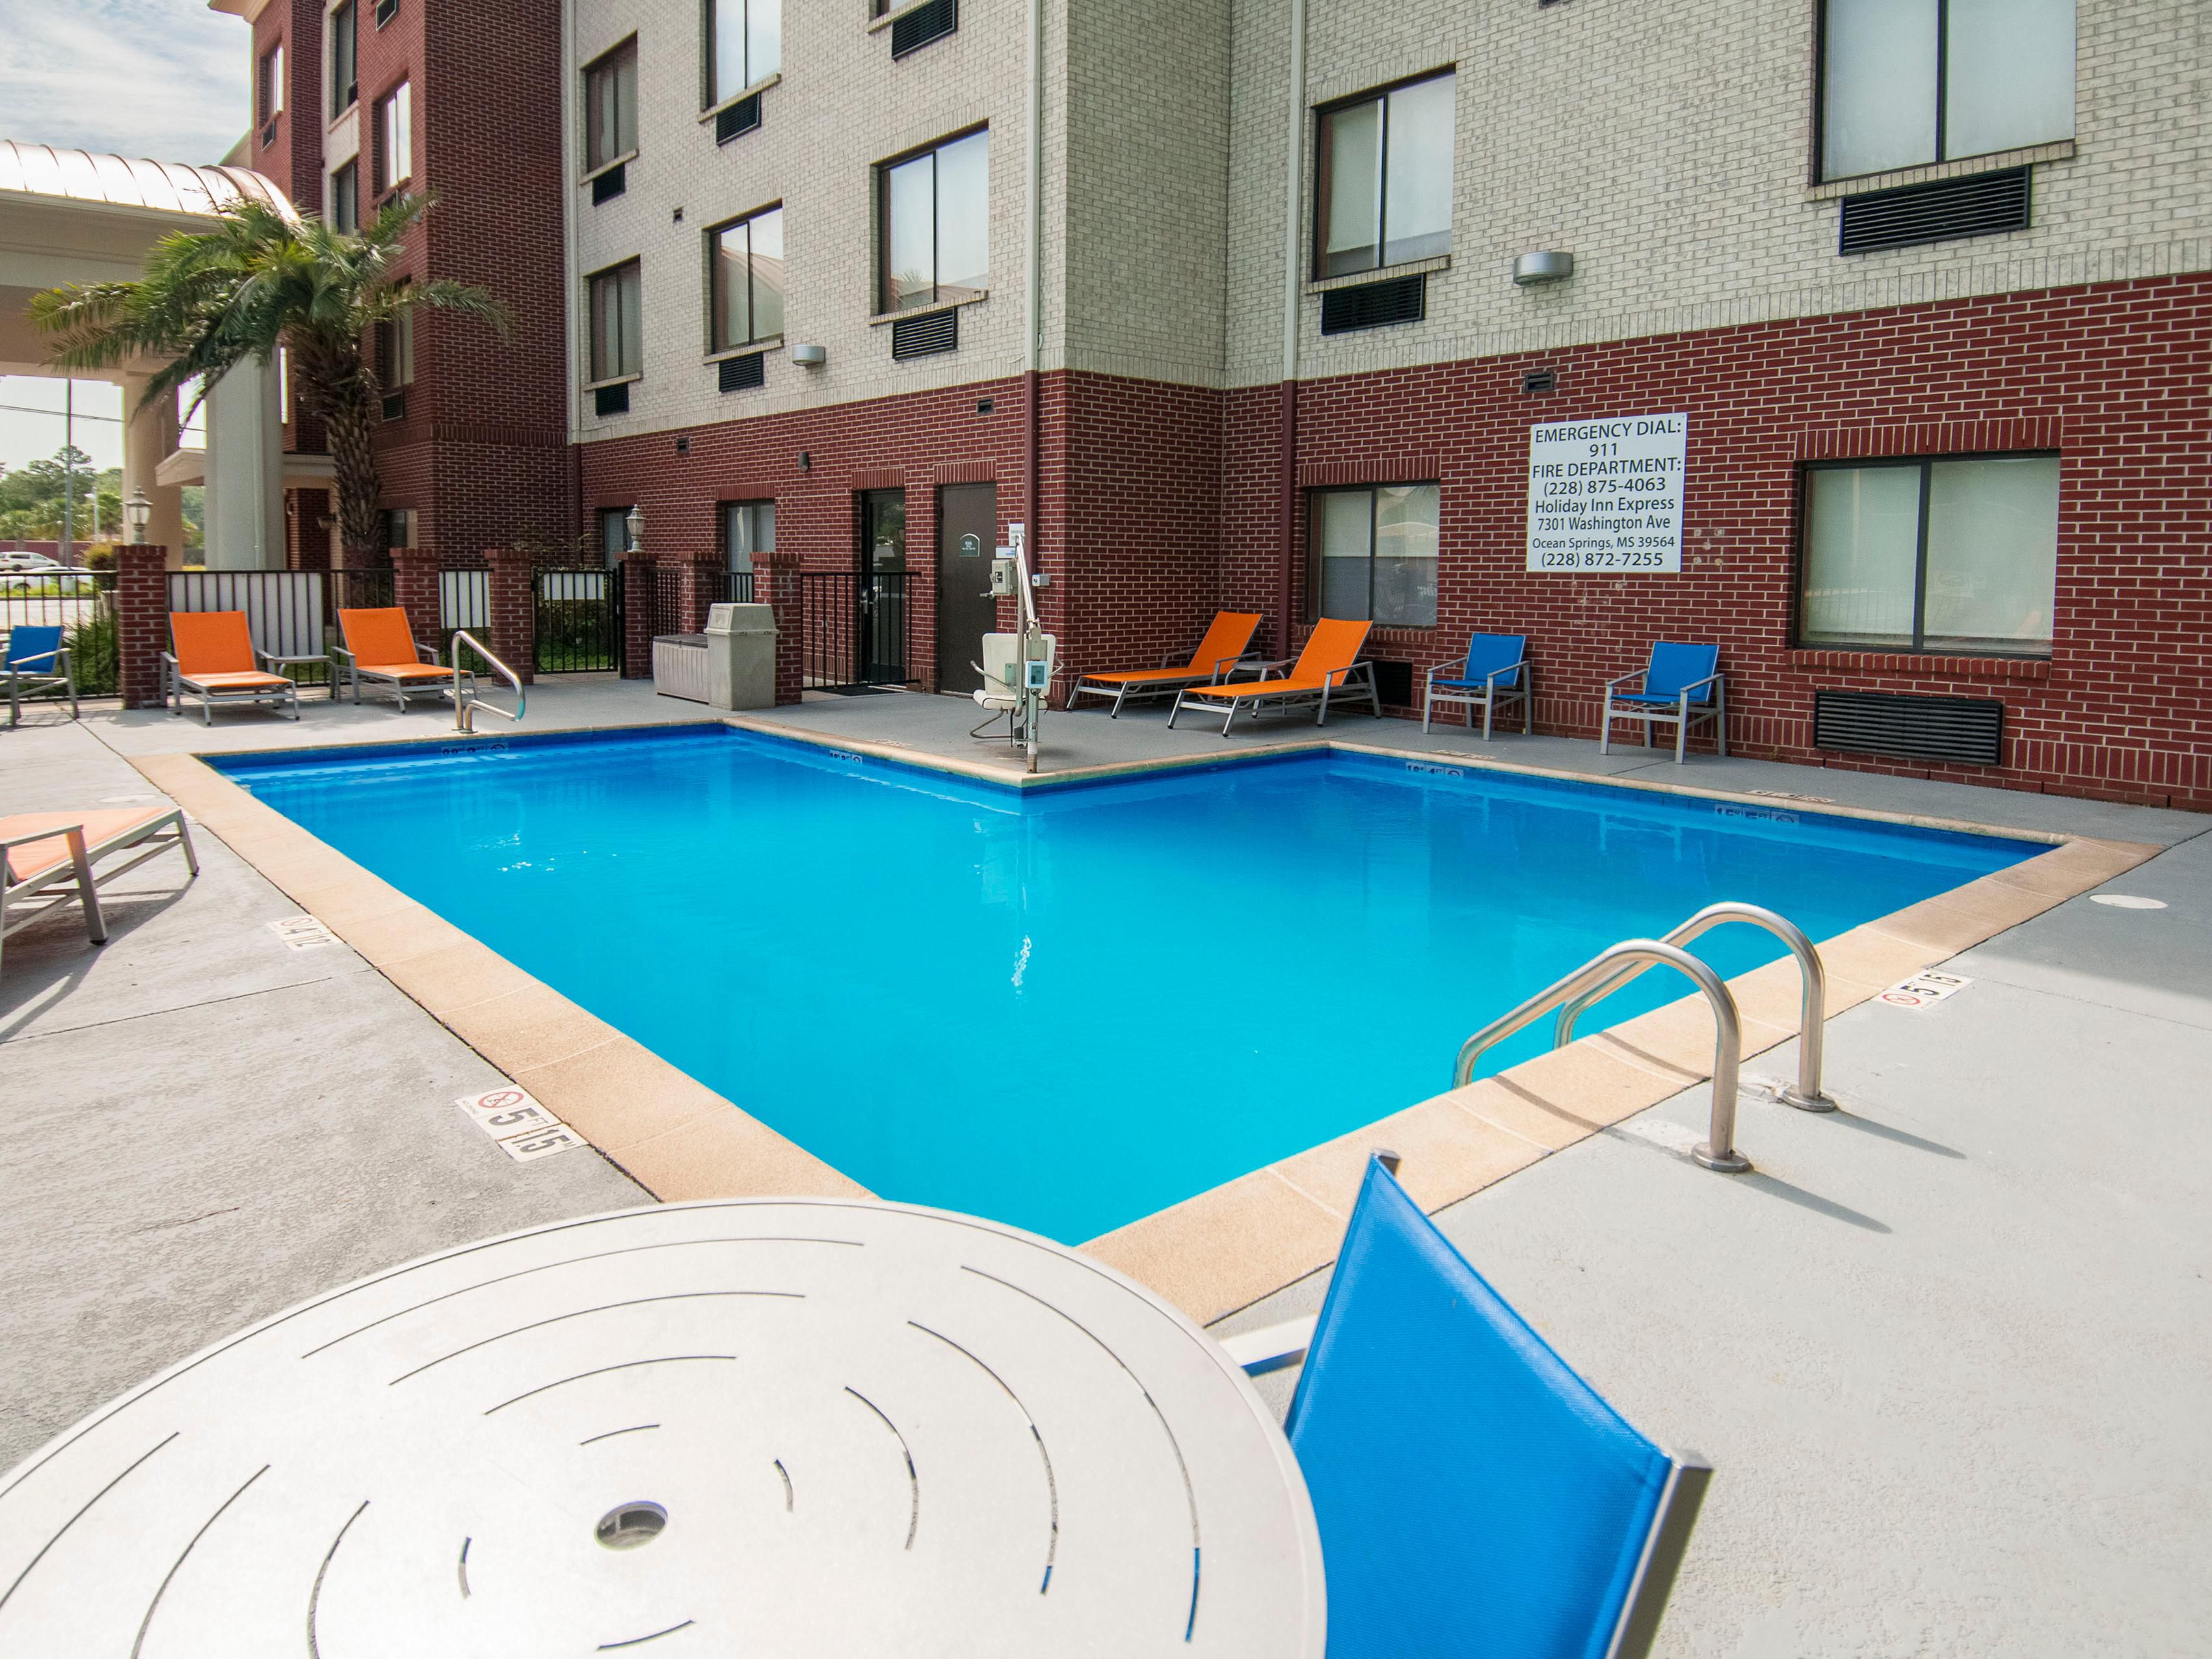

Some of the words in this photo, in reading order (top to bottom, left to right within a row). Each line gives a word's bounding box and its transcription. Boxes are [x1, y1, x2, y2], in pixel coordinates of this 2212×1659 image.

[1536, 422, 1632, 443] EMERGENCY
[1636, 419, 1681, 435] DIAL:
[1590, 443, 1618, 457] 911
[1532, 464, 1564, 479] FIRE
[1567, 457, 1681, 477] DEPARTMENT:
[1544, 480, 1582, 497] (228)
[1587, 477, 1666, 493] 875-4063
[1535, 499, 1588, 515] Holiday
[1591, 498, 1614, 512] Inn
[1618, 498, 1675, 514] Express
[1538, 518, 1565, 531] 7301
[1568, 516, 1642, 533] Washington
[1646, 514, 1671, 529] Ave
[1532, 538, 1566, 549] Ocean
[1569, 537, 1614, 551] Springs,
[1617, 537, 1635, 548] MS
[1638, 536, 1675, 548] 39564
[1541, 552, 1580, 568] (228)
[1584, 552, 1663, 566] 872-7255
